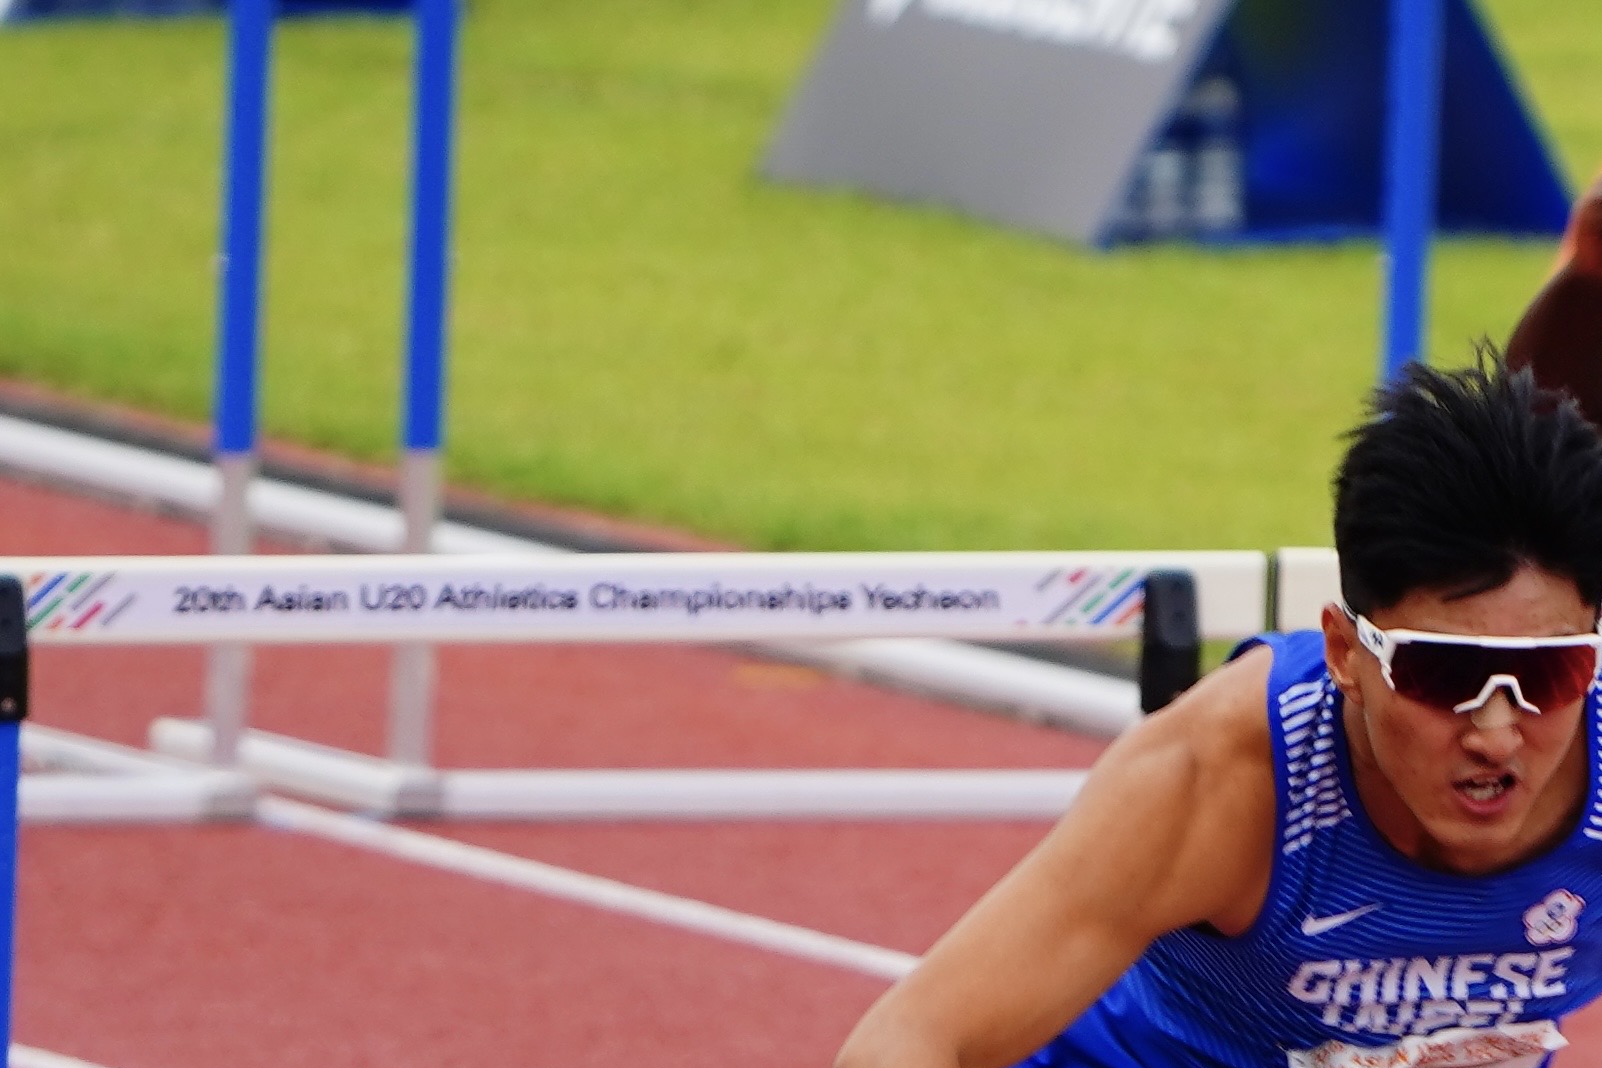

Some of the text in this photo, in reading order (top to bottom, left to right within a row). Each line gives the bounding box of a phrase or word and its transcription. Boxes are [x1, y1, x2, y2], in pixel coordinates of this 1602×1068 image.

[172, 581, 1000, 615] 20th Asian U20 Athletics Championships Yecheon
